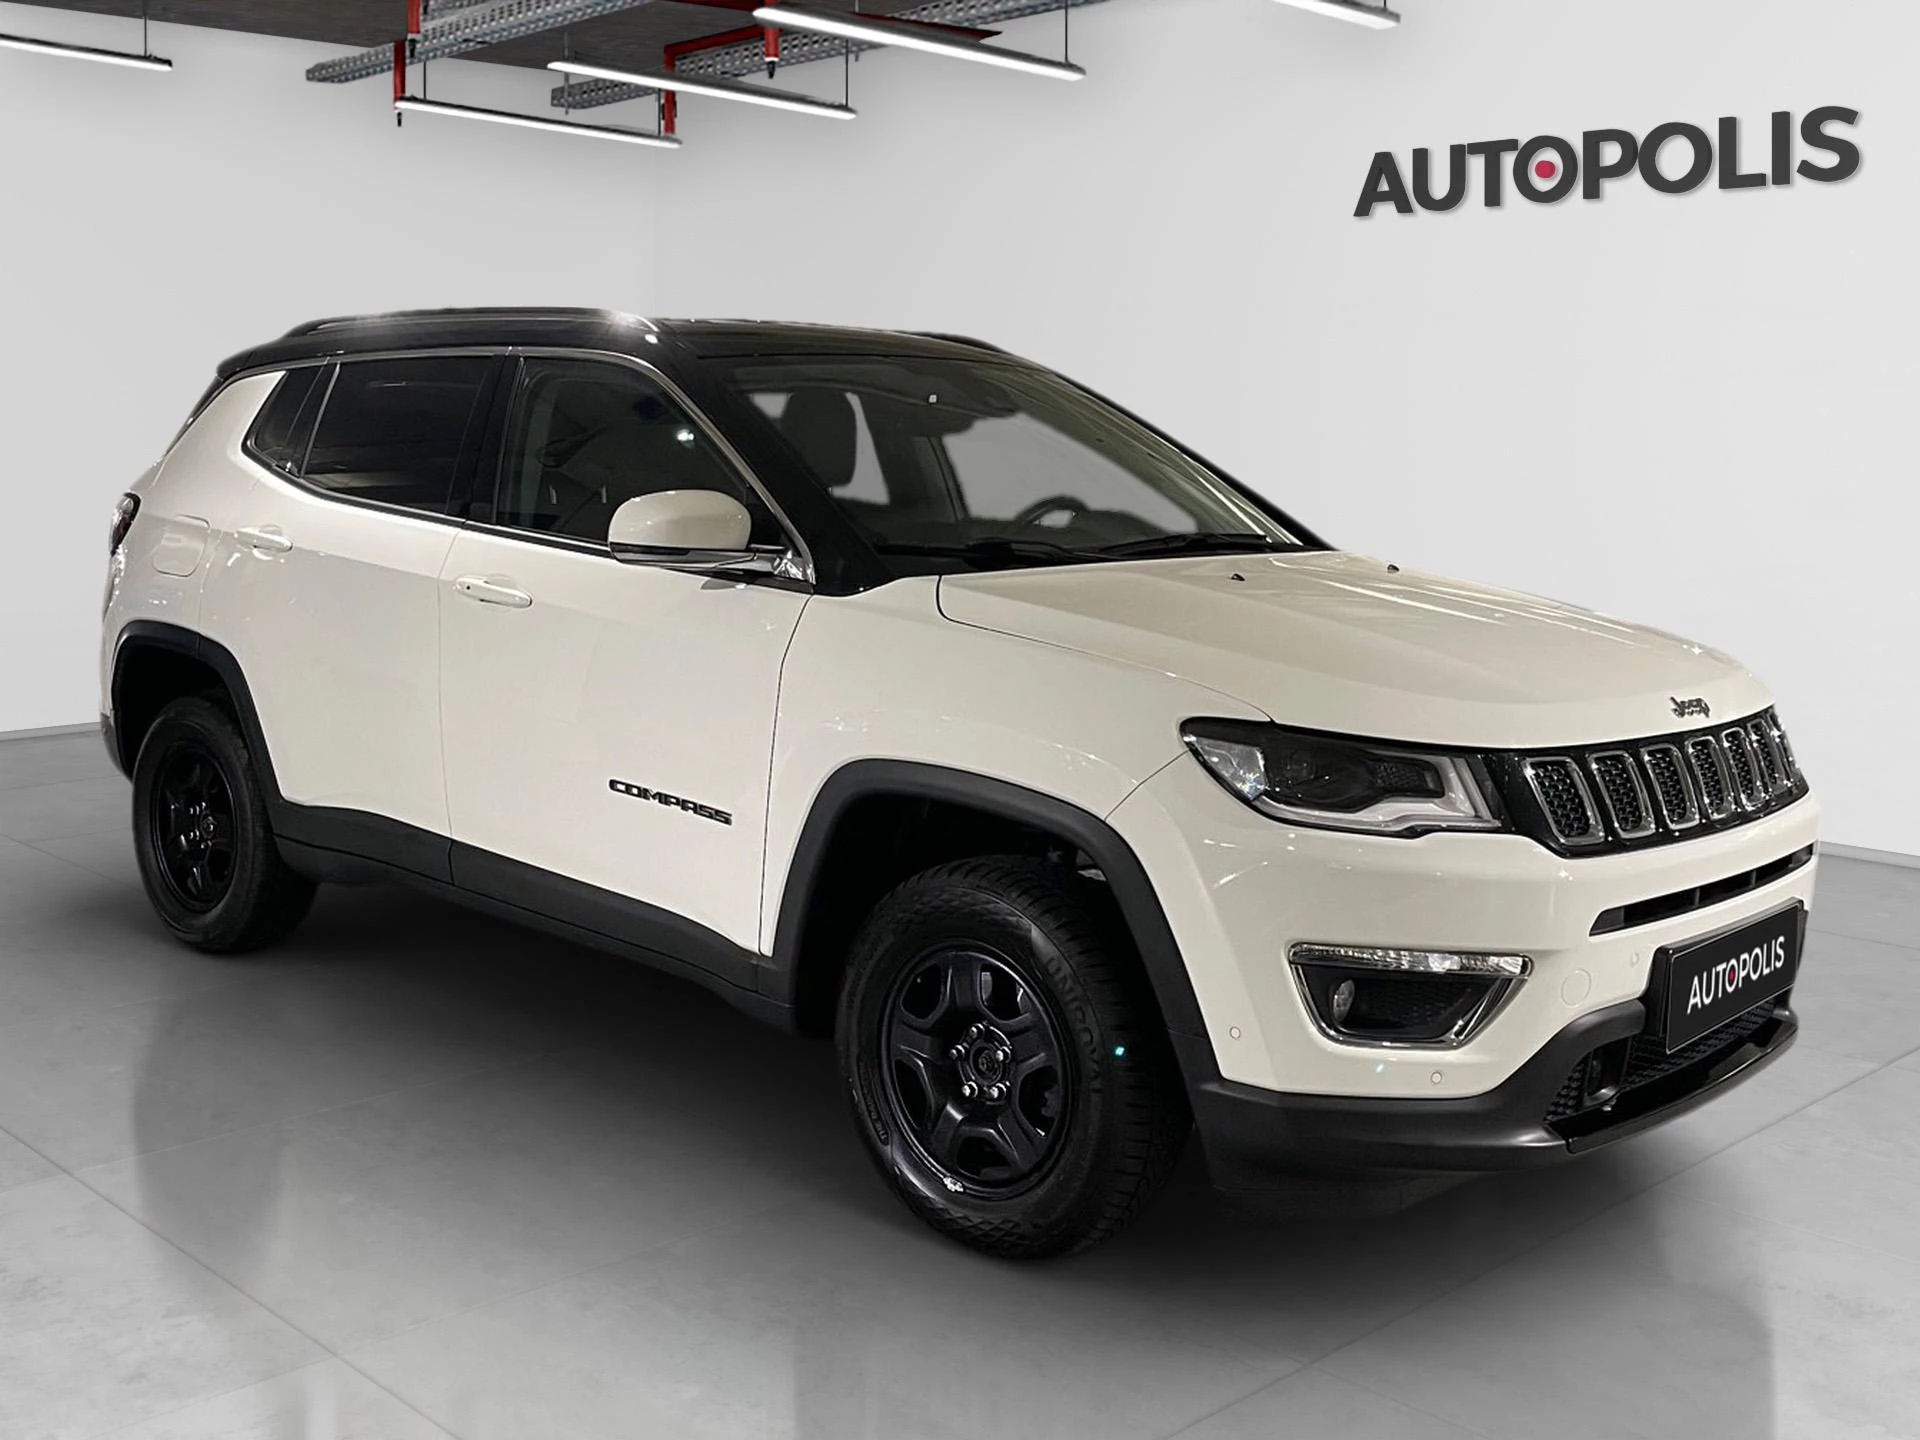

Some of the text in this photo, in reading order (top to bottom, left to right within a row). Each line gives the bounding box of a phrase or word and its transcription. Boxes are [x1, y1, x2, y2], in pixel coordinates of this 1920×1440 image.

[1353, 105, 1861, 218] AUTOPOLIS
[608, 779, 732, 826] COMPASS
[1686, 935, 1785, 1015] AUTOPOLIS
